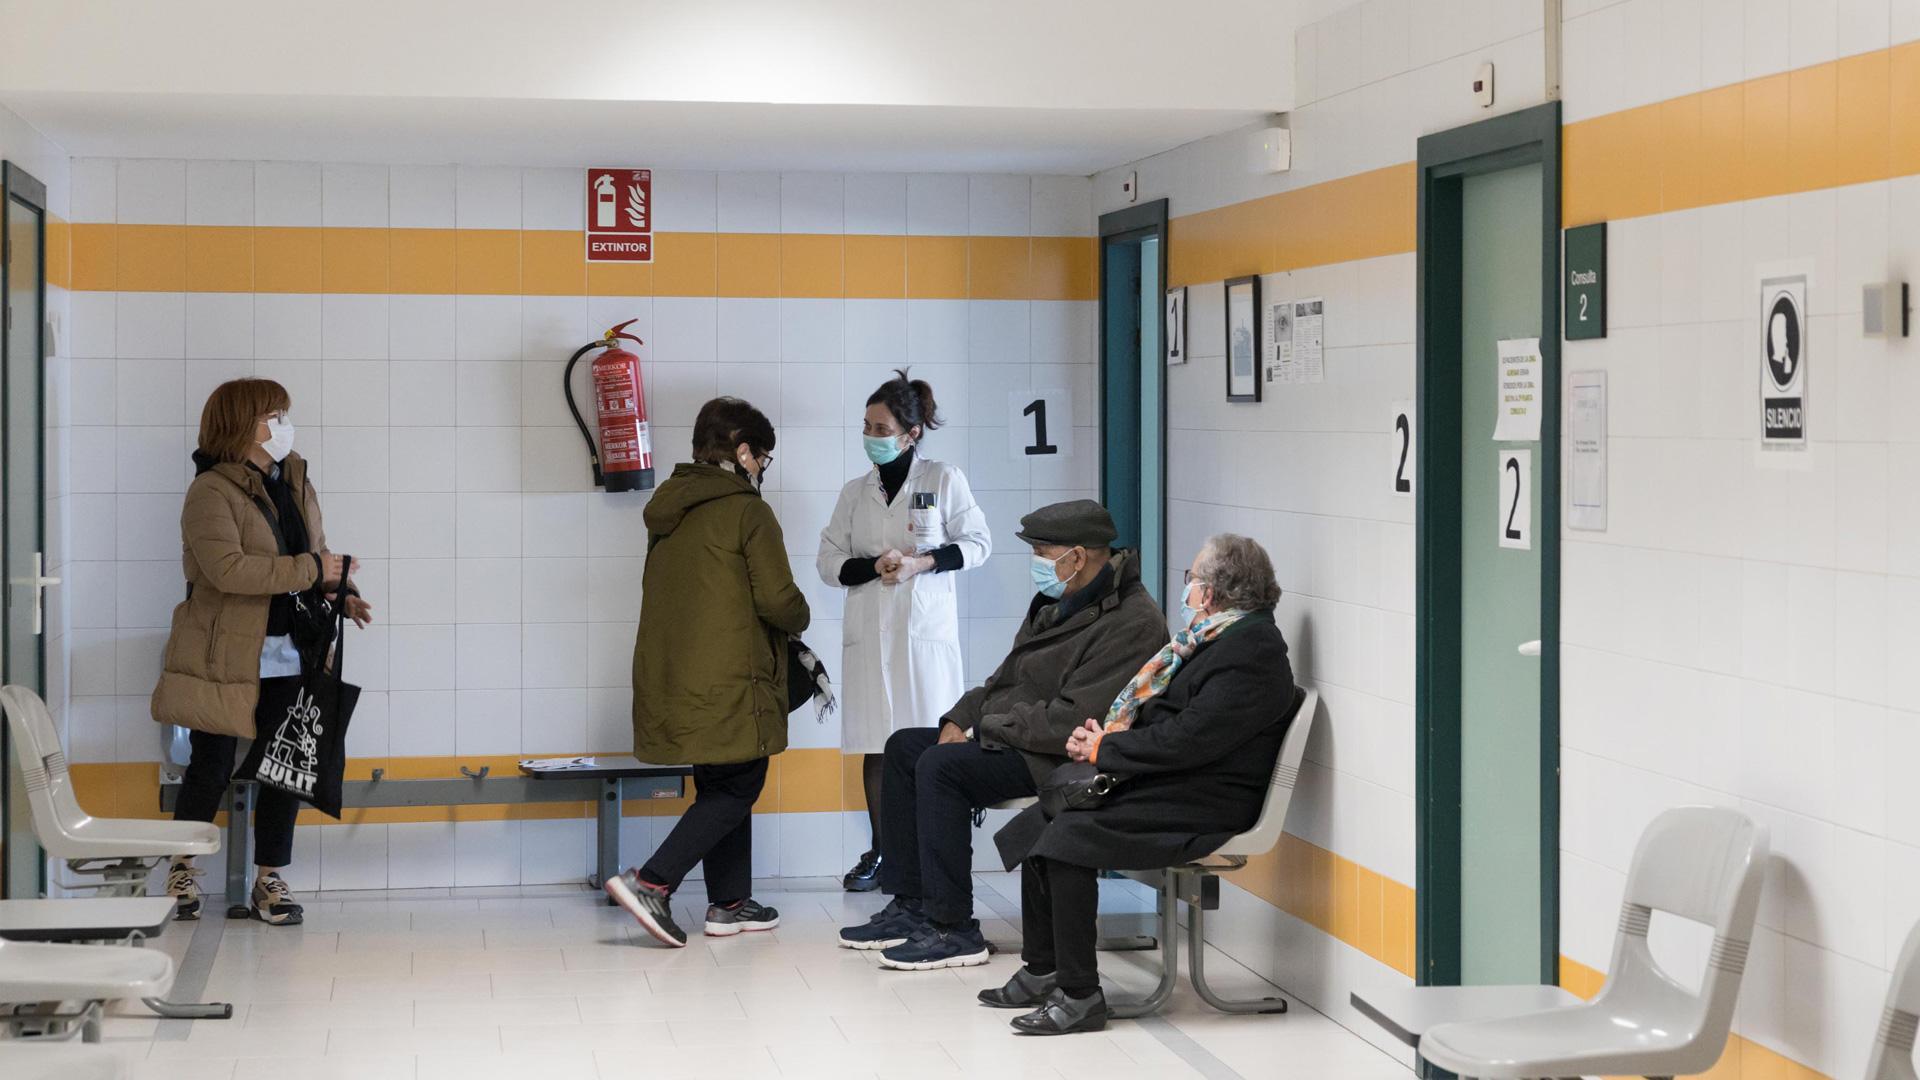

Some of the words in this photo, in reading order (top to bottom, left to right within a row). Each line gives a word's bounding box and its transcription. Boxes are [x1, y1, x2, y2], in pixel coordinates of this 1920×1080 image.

[592, 242, 647, 252] EXTINTOR
[1571, 270, 1596, 285] Consulta
[1579, 293, 1588, 321] 2
[1171, 297, 1179, 357] 1
[1023, 399, 1058, 455] 1
[1766, 408, 1801, 428] SILENCIO
[1396, 413, 1410, 492] 2
[1506, 457, 1521, 540] 2
[258, 756, 317, 792] BULIT
